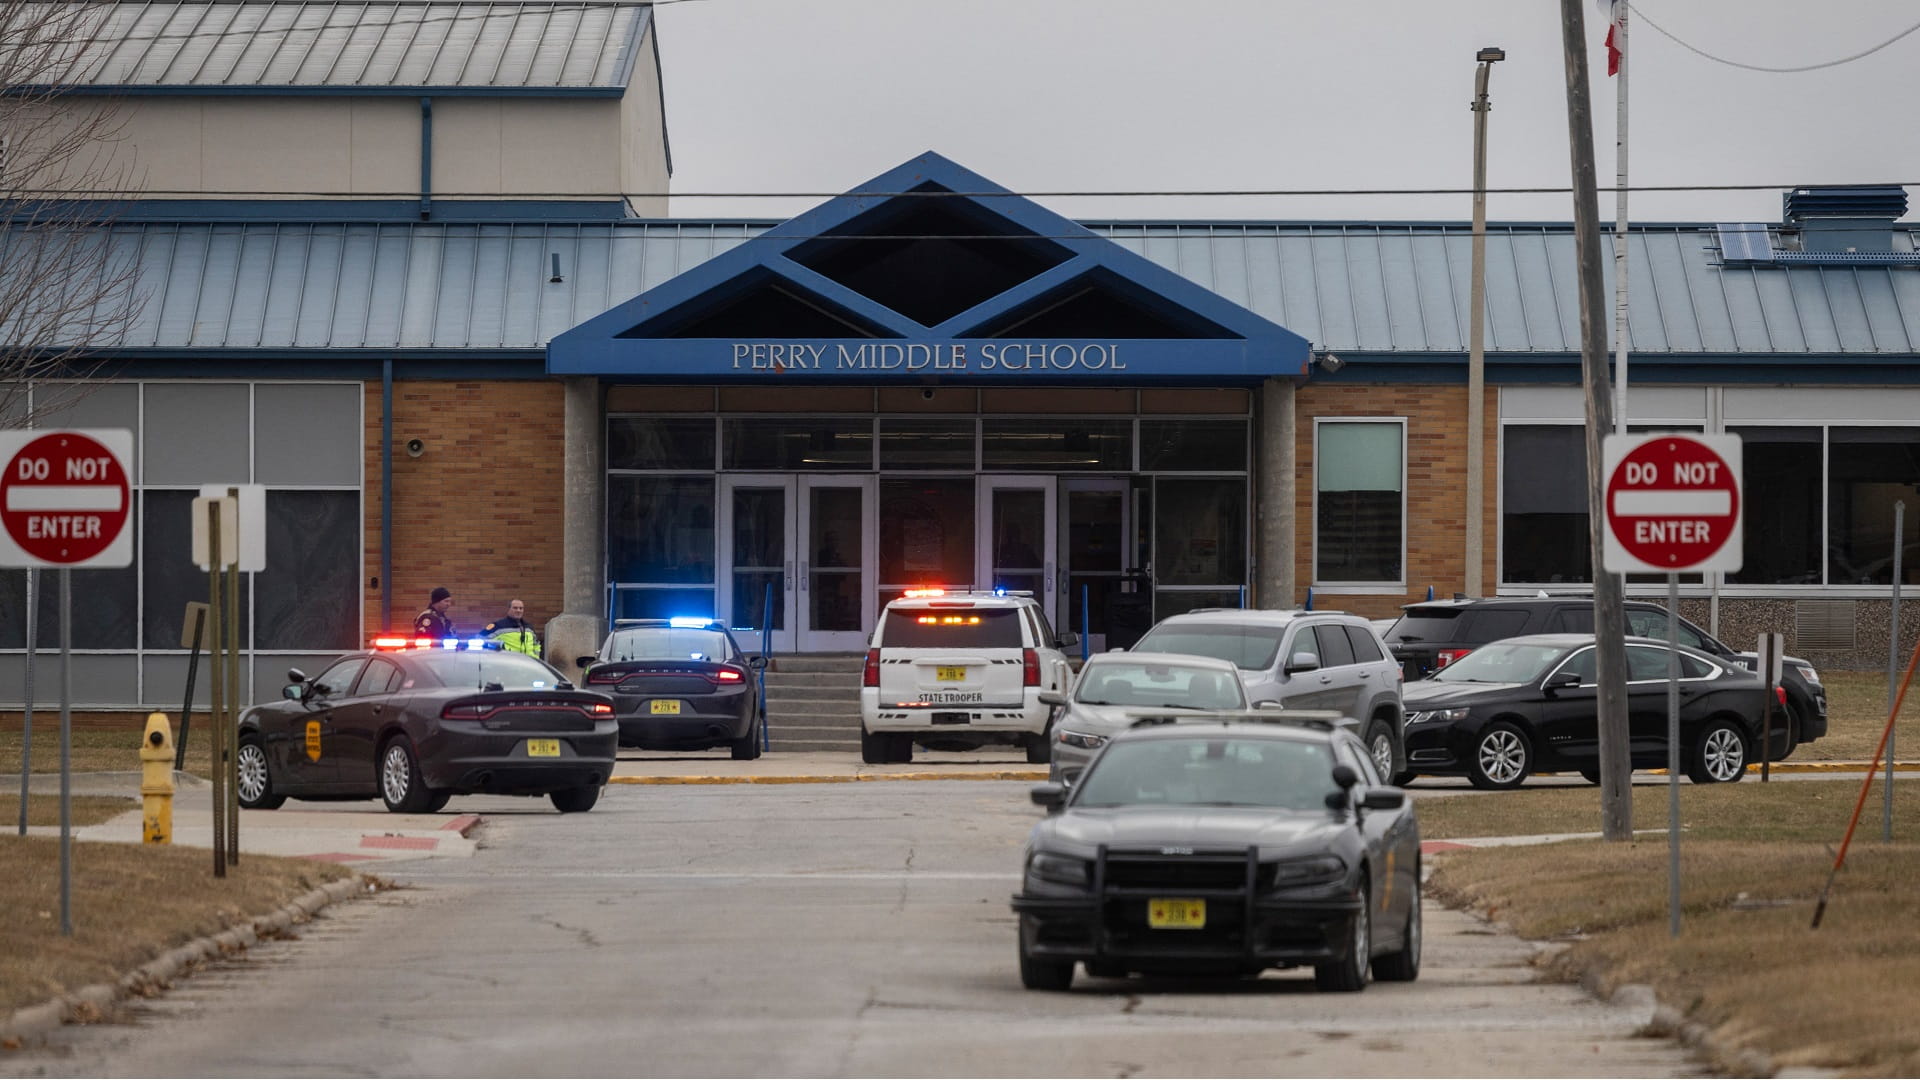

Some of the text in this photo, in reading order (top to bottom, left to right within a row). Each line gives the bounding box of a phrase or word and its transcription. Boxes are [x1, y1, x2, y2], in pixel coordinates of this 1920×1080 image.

[732, 344, 1127, 370] PERRY MIDDLE SCHOOL
[18, 457, 111, 480] DO NOT
[1625, 461, 1720, 485] DO NOT
[27, 516, 102, 539] ENTER
[1635, 521, 1711, 544] ENTER
[919, 692, 983, 703] STATE TROOPER
